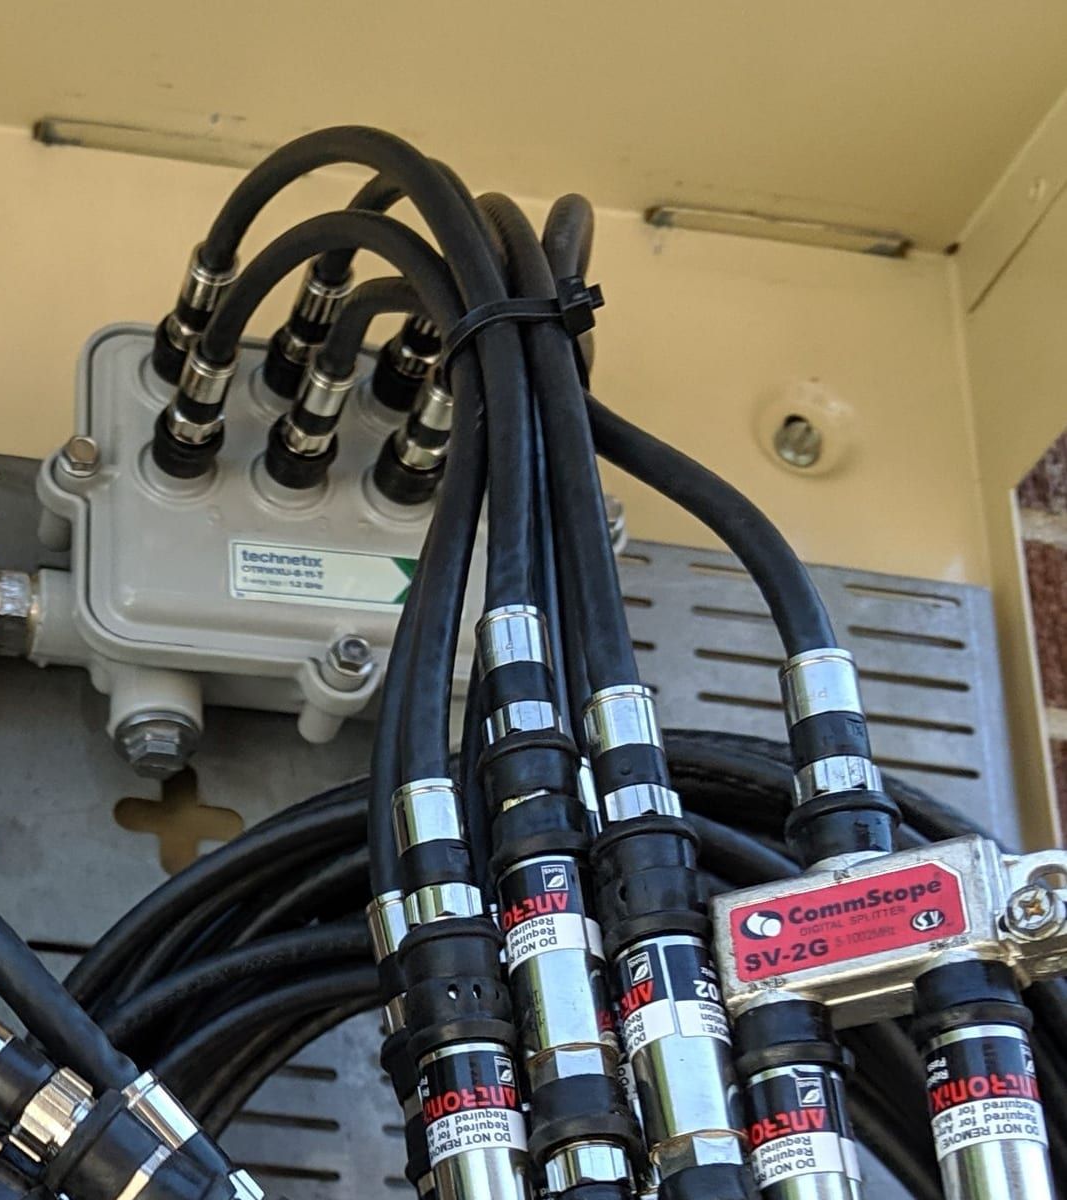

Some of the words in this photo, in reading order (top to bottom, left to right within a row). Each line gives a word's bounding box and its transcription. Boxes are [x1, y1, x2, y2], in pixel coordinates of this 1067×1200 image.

[241, 550, 324, 567] technetix
[788, 878, 943, 926] CommScope
[509, 916, 554, 940] Required
[799, 920, 844, 937] DIGITAL
[849, 905, 907, 926] SPLITTER
[510, 926, 556, 950] Required
[538, 935, 557, 947] DO
[516, 941, 536, 956] NOT
[744, 938, 830, 973] SV-2G
[632, 1031, 646, 1044] DO
[454, 1108, 507, 1122] Required
[957, 1104, 975, 1115] for
[436, 1118, 449, 1130] for
[455, 1118, 509, 1134] Required
[958, 1116, 976, 1127] for
[994, 1124, 1021, 1133] NOT
[437, 1129, 449, 1141] for
[465, 1132, 490, 1144] NOT
[493, 1132, 511, 1141] DO
[429, 1137, 461, 1156] REMO
[759, 1135, 812, 1155] Required
[760, 1146, 813, 1167] Required
[795, 1157, 816, 1167] DO
[768, 1162, 792, 1177] NOT
